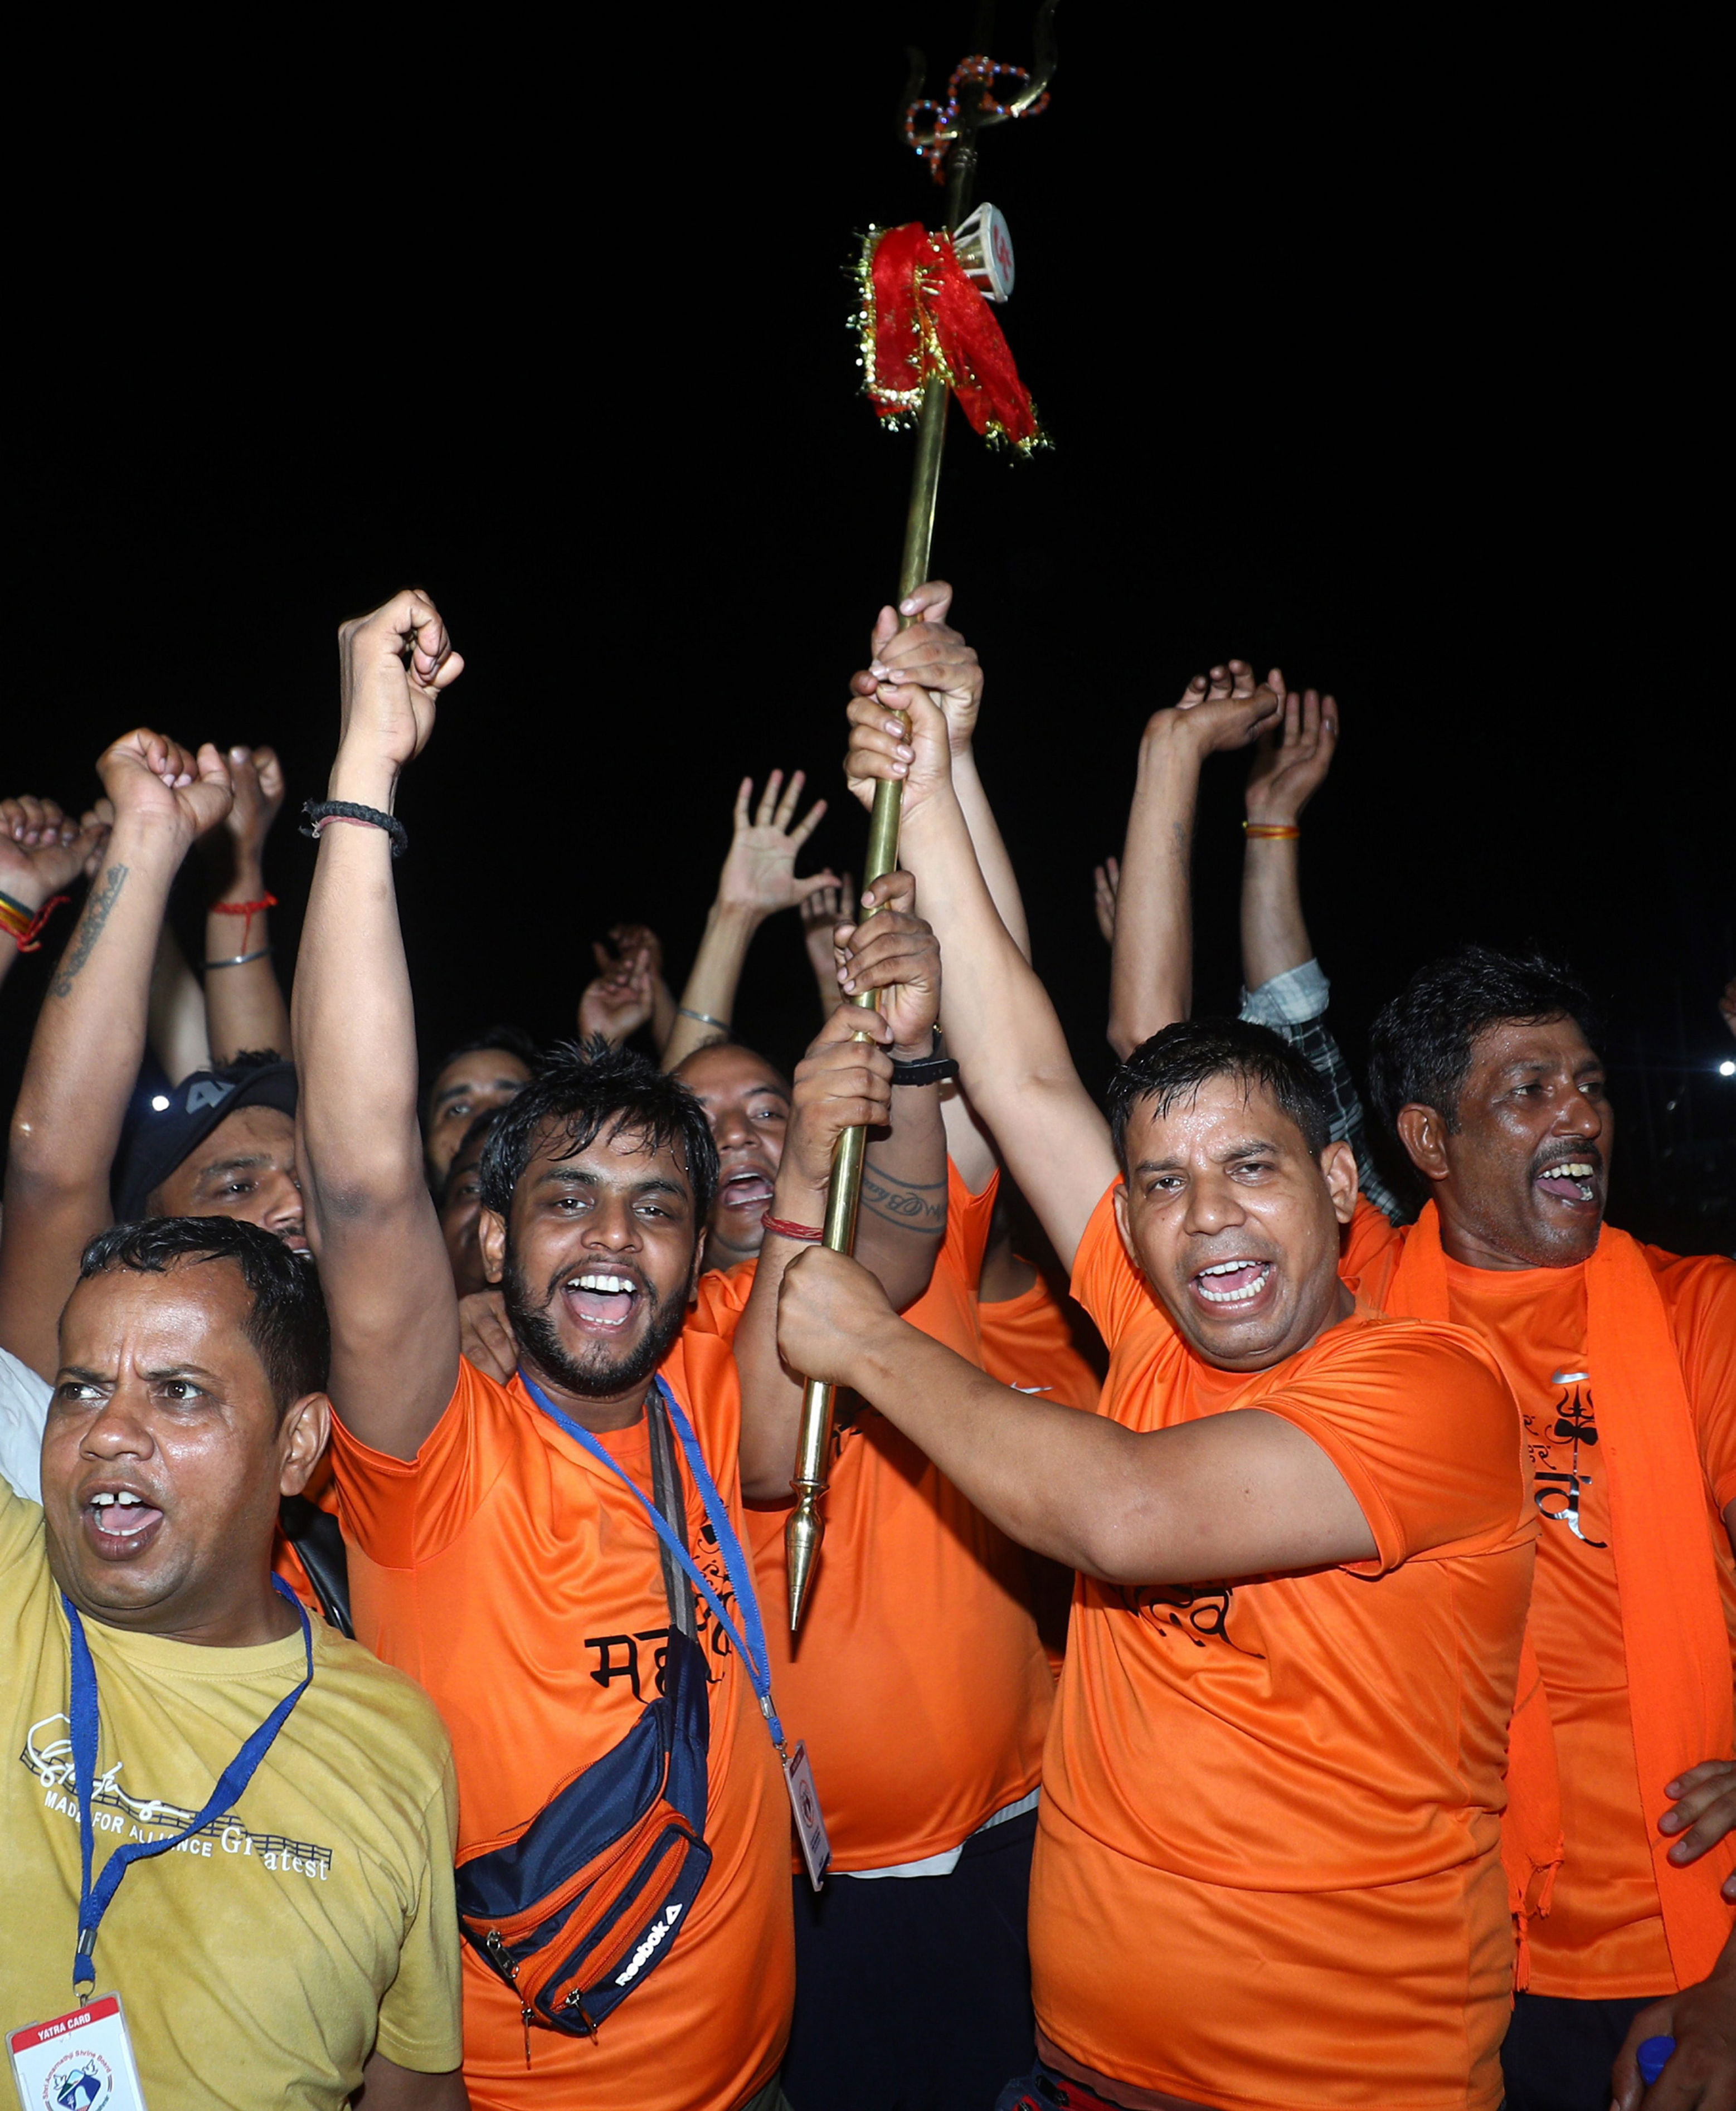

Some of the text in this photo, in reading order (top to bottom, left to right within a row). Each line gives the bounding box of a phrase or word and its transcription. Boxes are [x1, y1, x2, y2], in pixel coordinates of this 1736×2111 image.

[92, 1811, 124, 1833] FOR
[221, 1826, 328, 1881] Gratest
[615, 1920, 670, 1987] Reebok
[37, 2013, 91, 2041] YATRA CARD
